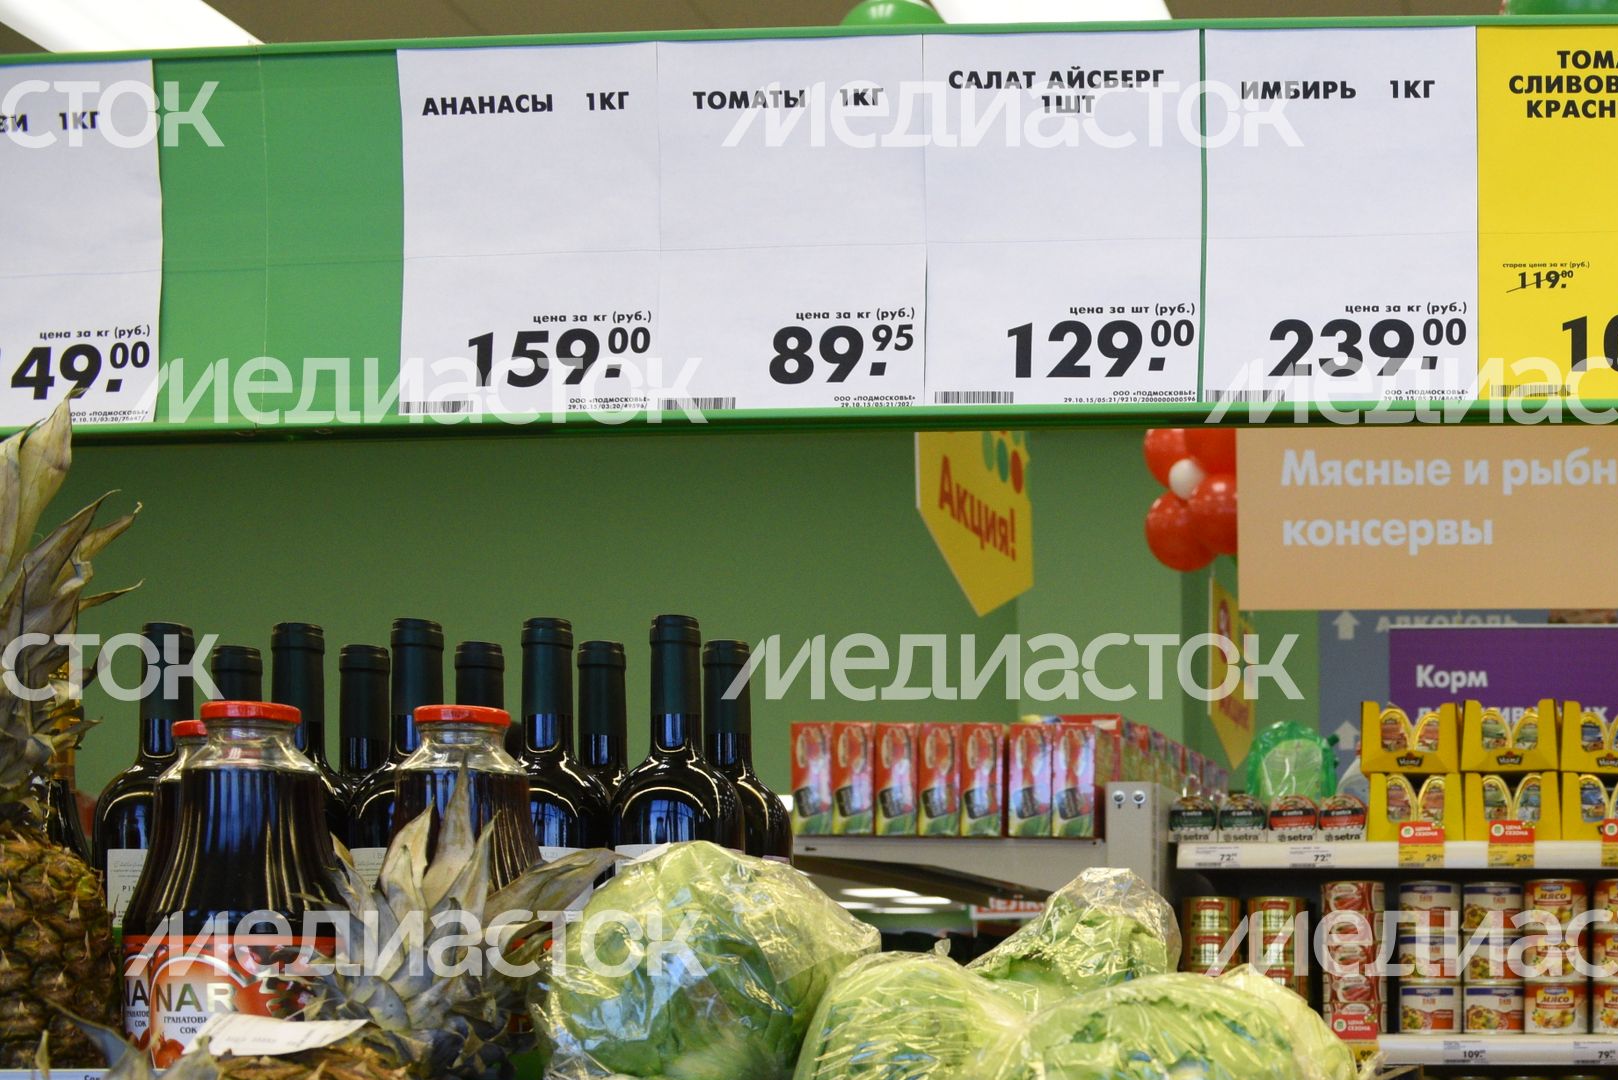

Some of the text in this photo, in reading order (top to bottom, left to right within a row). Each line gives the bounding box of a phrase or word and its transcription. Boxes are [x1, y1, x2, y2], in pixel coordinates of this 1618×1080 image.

[949, 66, 1164, 89] САЛАТ АЙСБЕРГ
[1241, 80, 1435, 99] ИМБИРЬ 1КГ
[422, 91, 629, 116] АНАНАСЫ 1КГ
[693, 88, 883, 110] ТОМАТЫ 1КГ
[1042, 95, 1095, 113] 1ШТ
[59, 111, 99, 130] 1КГ
[533, 315, 566, 324] цена
[613, 311, 651, 323] (руб.)
[796, 312, 829, 321] цена
[876, 307, 914, 320] (руб.)
[1070, 307, 1103, 316] цена
[1155, 303, 1195, 316] (руб.)
[1345, 305, 1379, 314] цена
[1427, 302, 1467, 315] (руб.)
[40, 332, 71, 340] цена
[114, 324, 150, 339] (руб.)
[1281, 450, 1450, 486] Мясные
[1463, 459, 1489, 485] и
[938, 455, 1017, 561] Акция!
[1282, 519, 1493, 555] консервы
[1416, 665, 1488, 693] Корм
[1183, 832, 1209, 841] setra
[1233, 832, 1260, 841] setra
[1287, 832, 1314, 842] setra
[1334, 832, 1361, 842] setra
